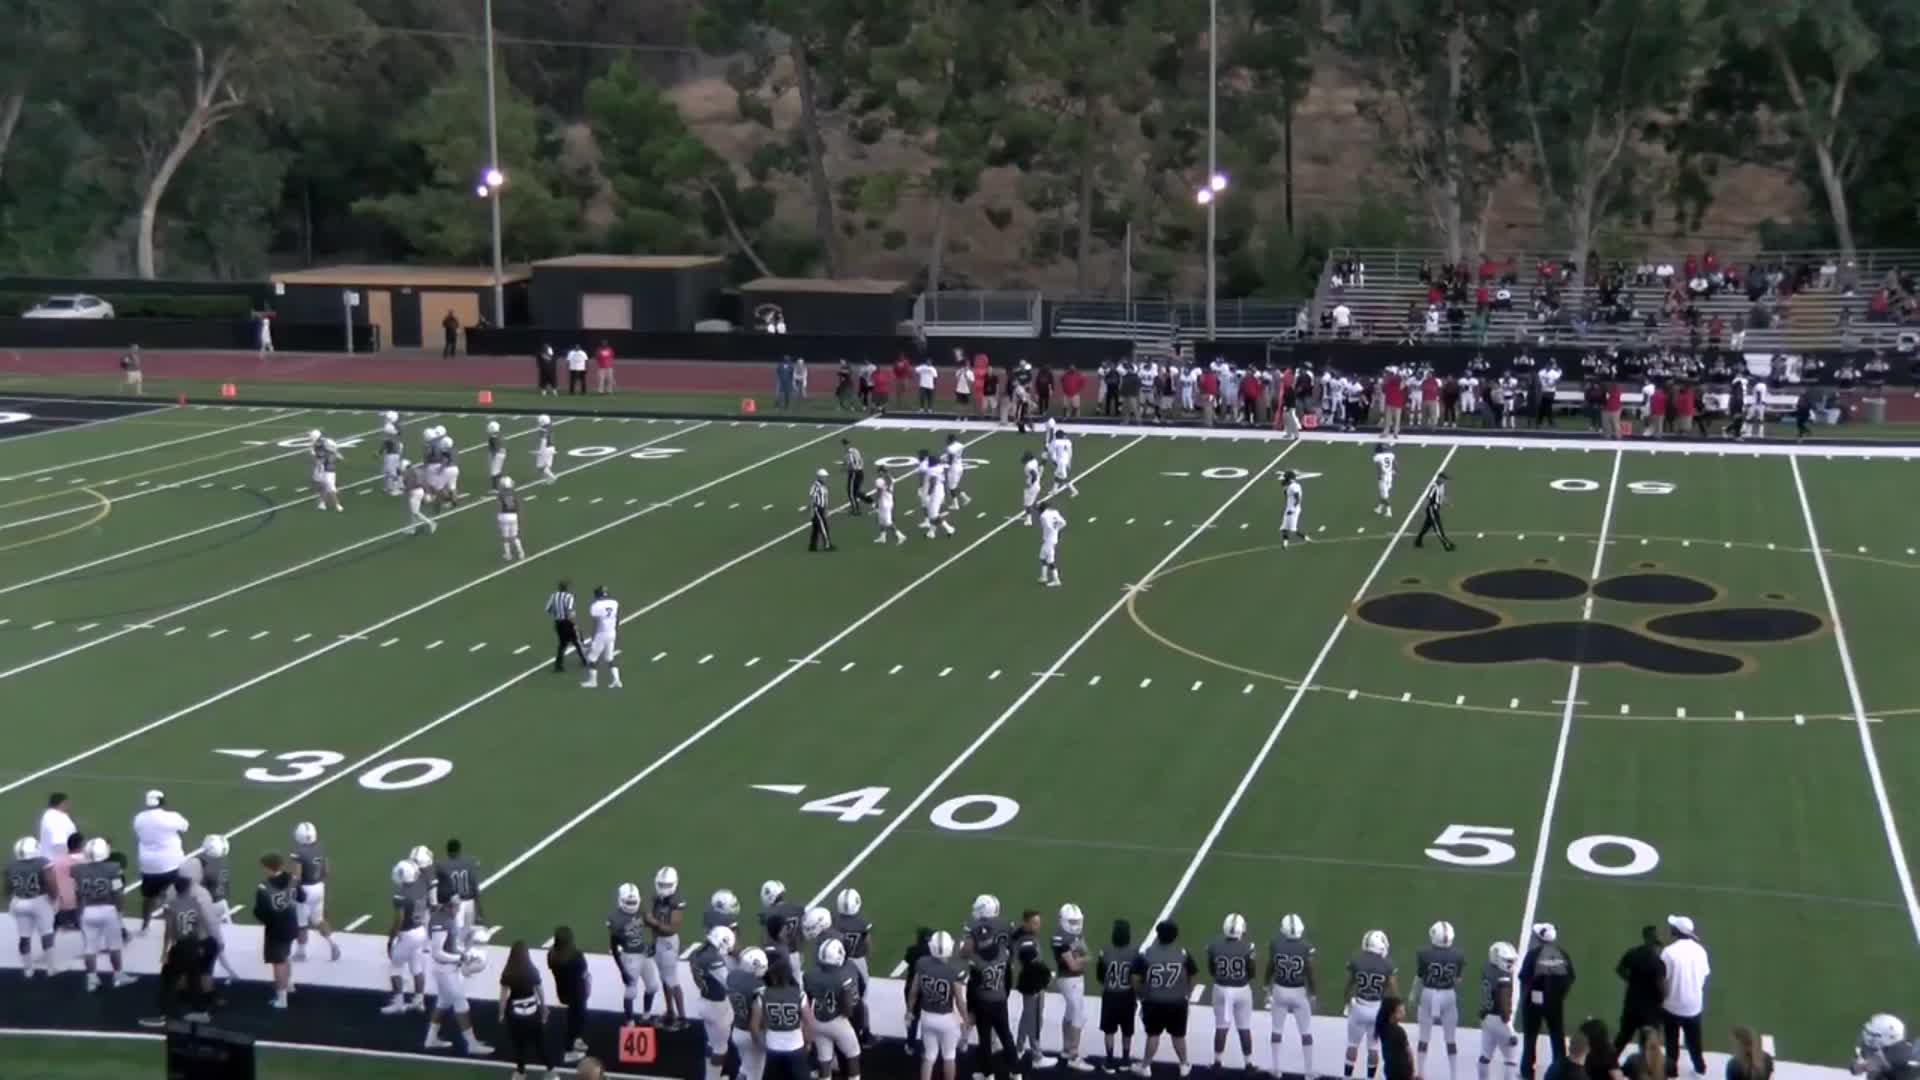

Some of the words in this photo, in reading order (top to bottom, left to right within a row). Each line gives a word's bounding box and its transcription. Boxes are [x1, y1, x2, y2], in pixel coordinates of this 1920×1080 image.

[1146, 961, 1182, 988] 67
[1215, 956, 1246, 981] 39
[1274, 952, 1305, 981] 52
[766, 1002, 801, 1027] 55
[623, 1031, 649, 1057] 40
